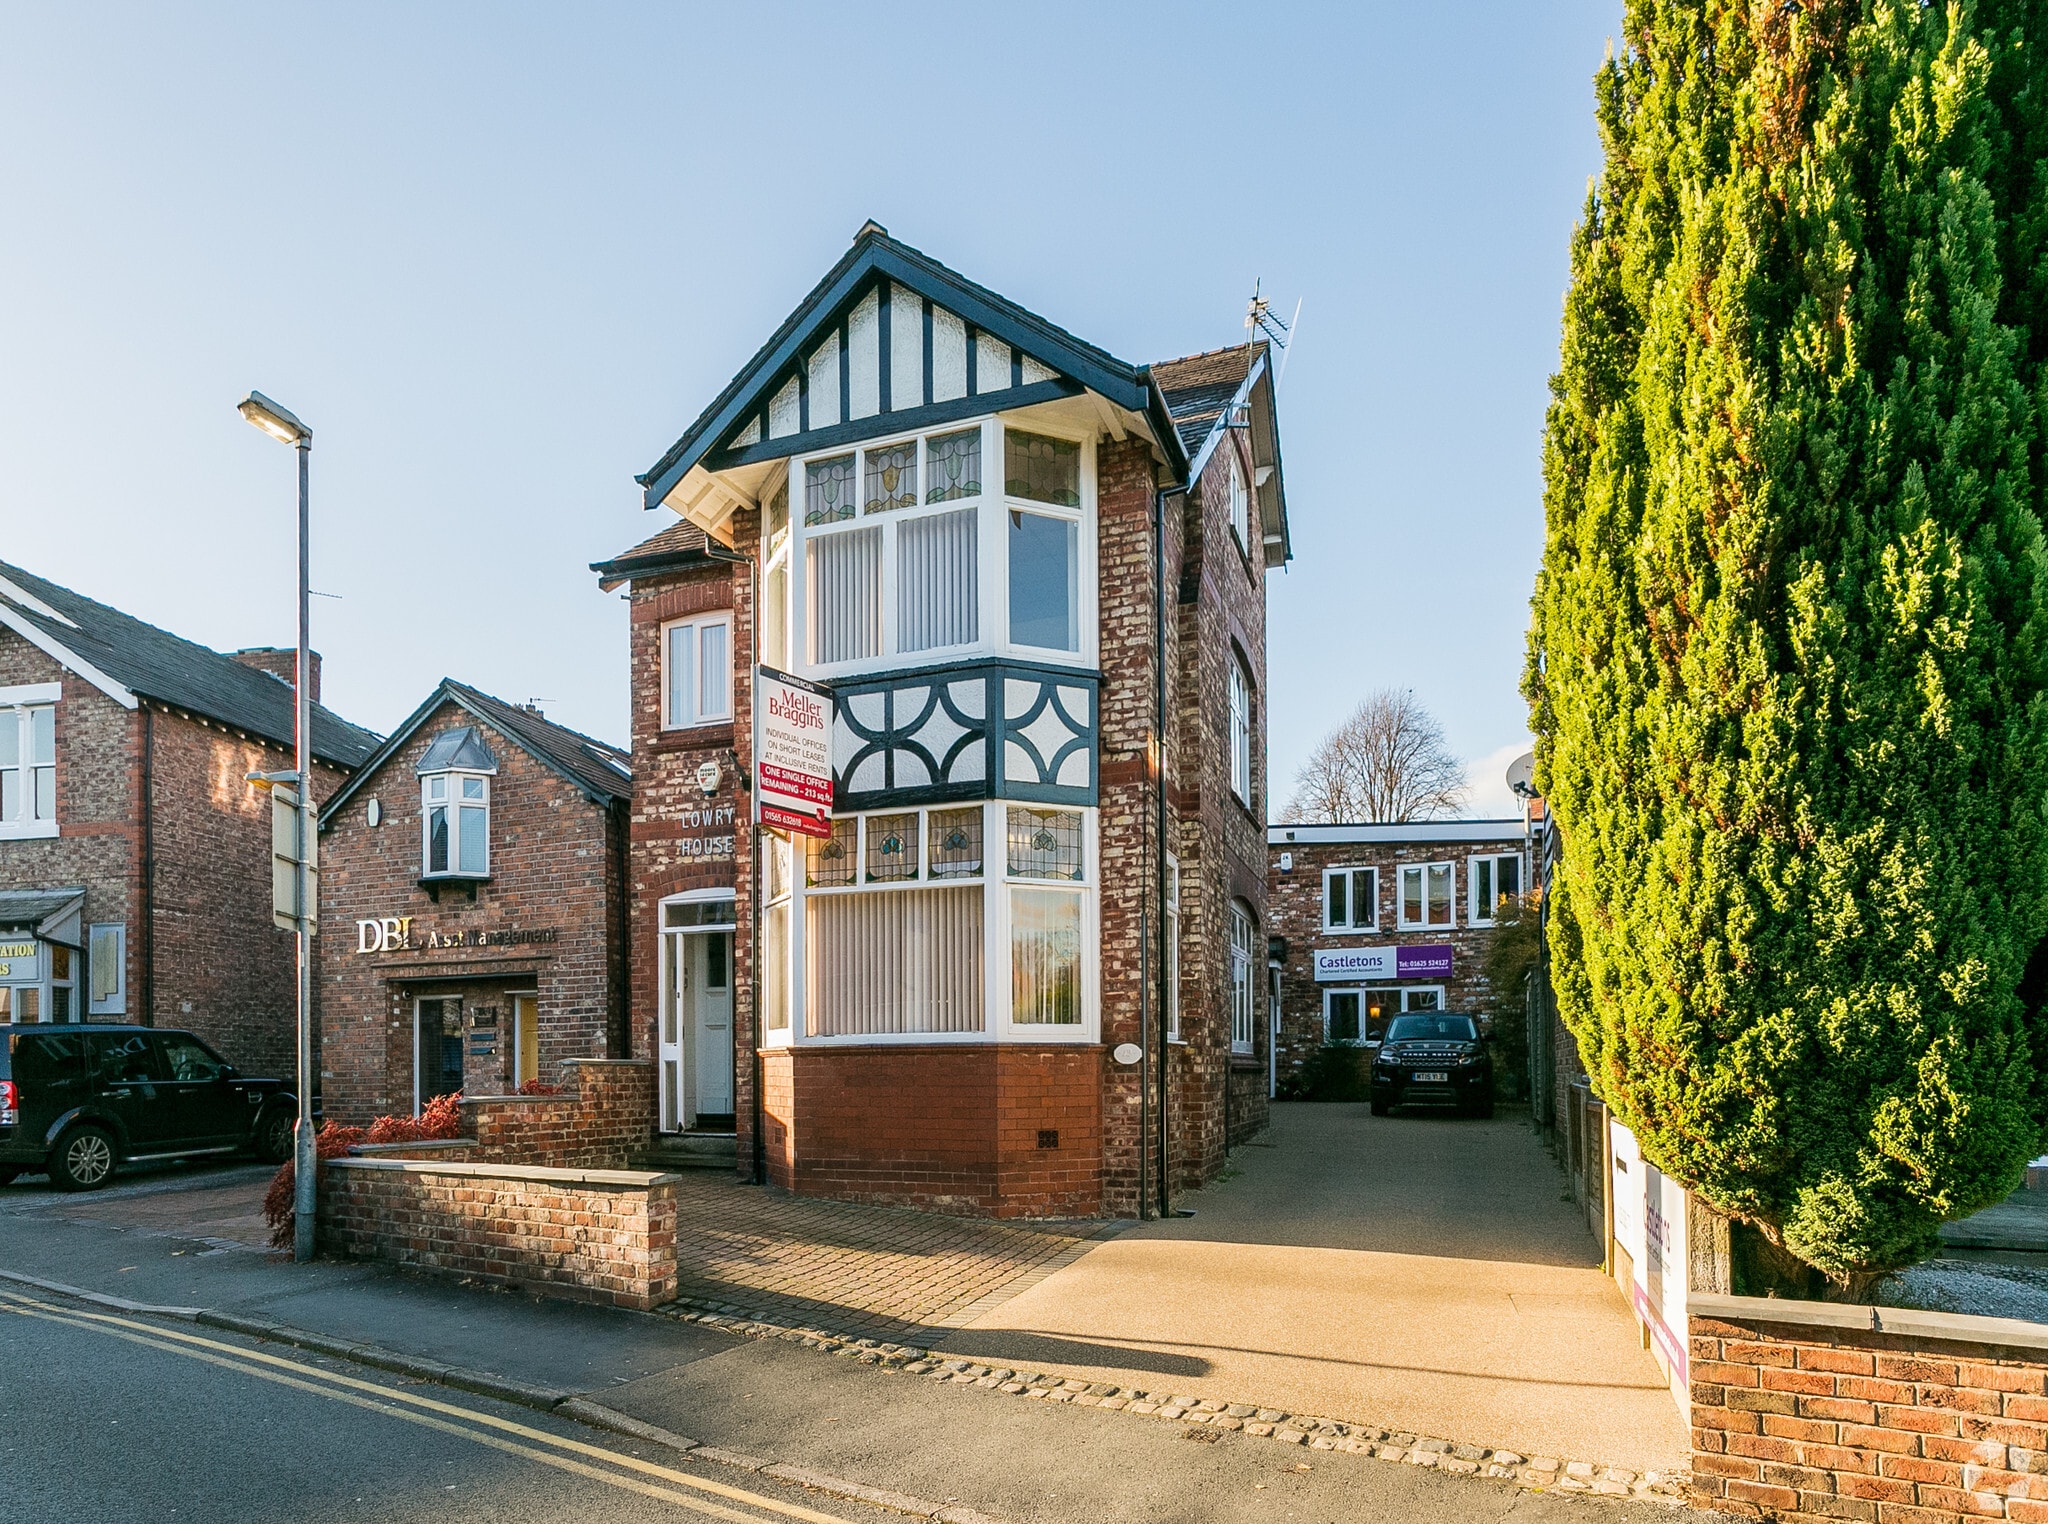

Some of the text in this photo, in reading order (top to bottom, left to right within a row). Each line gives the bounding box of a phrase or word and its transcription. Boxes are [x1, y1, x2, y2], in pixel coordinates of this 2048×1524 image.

[779, 673, 815, 692] COMMERCIAL
[769, 696, 824, 730] Braggins
[782, 688, 822, 717] Meller
[766, 727, 827, 753] INDIVIDUAL OFFICES
[767, 740, 826, 764] ON SHORT LEASES
[765, 752, 828, 776] AT INCLUSIVE RENTS
[761, 776, 799, 794] REMAINING
[804, 787, 816, 798] 213
[765, 765, 829, 790] ONE SINGLE OFFICE
[682, 808, 733, 829] LOWRY
[764, 811, 782, 823] 01565
[682, 836, 733, 856] HOUSE
[356, 916, 422, 953] DBL
[467, 926, 555, 947] Management
[0, 944, 36, 957] ATION
[1319, 955, 1383, 968] Castletons
